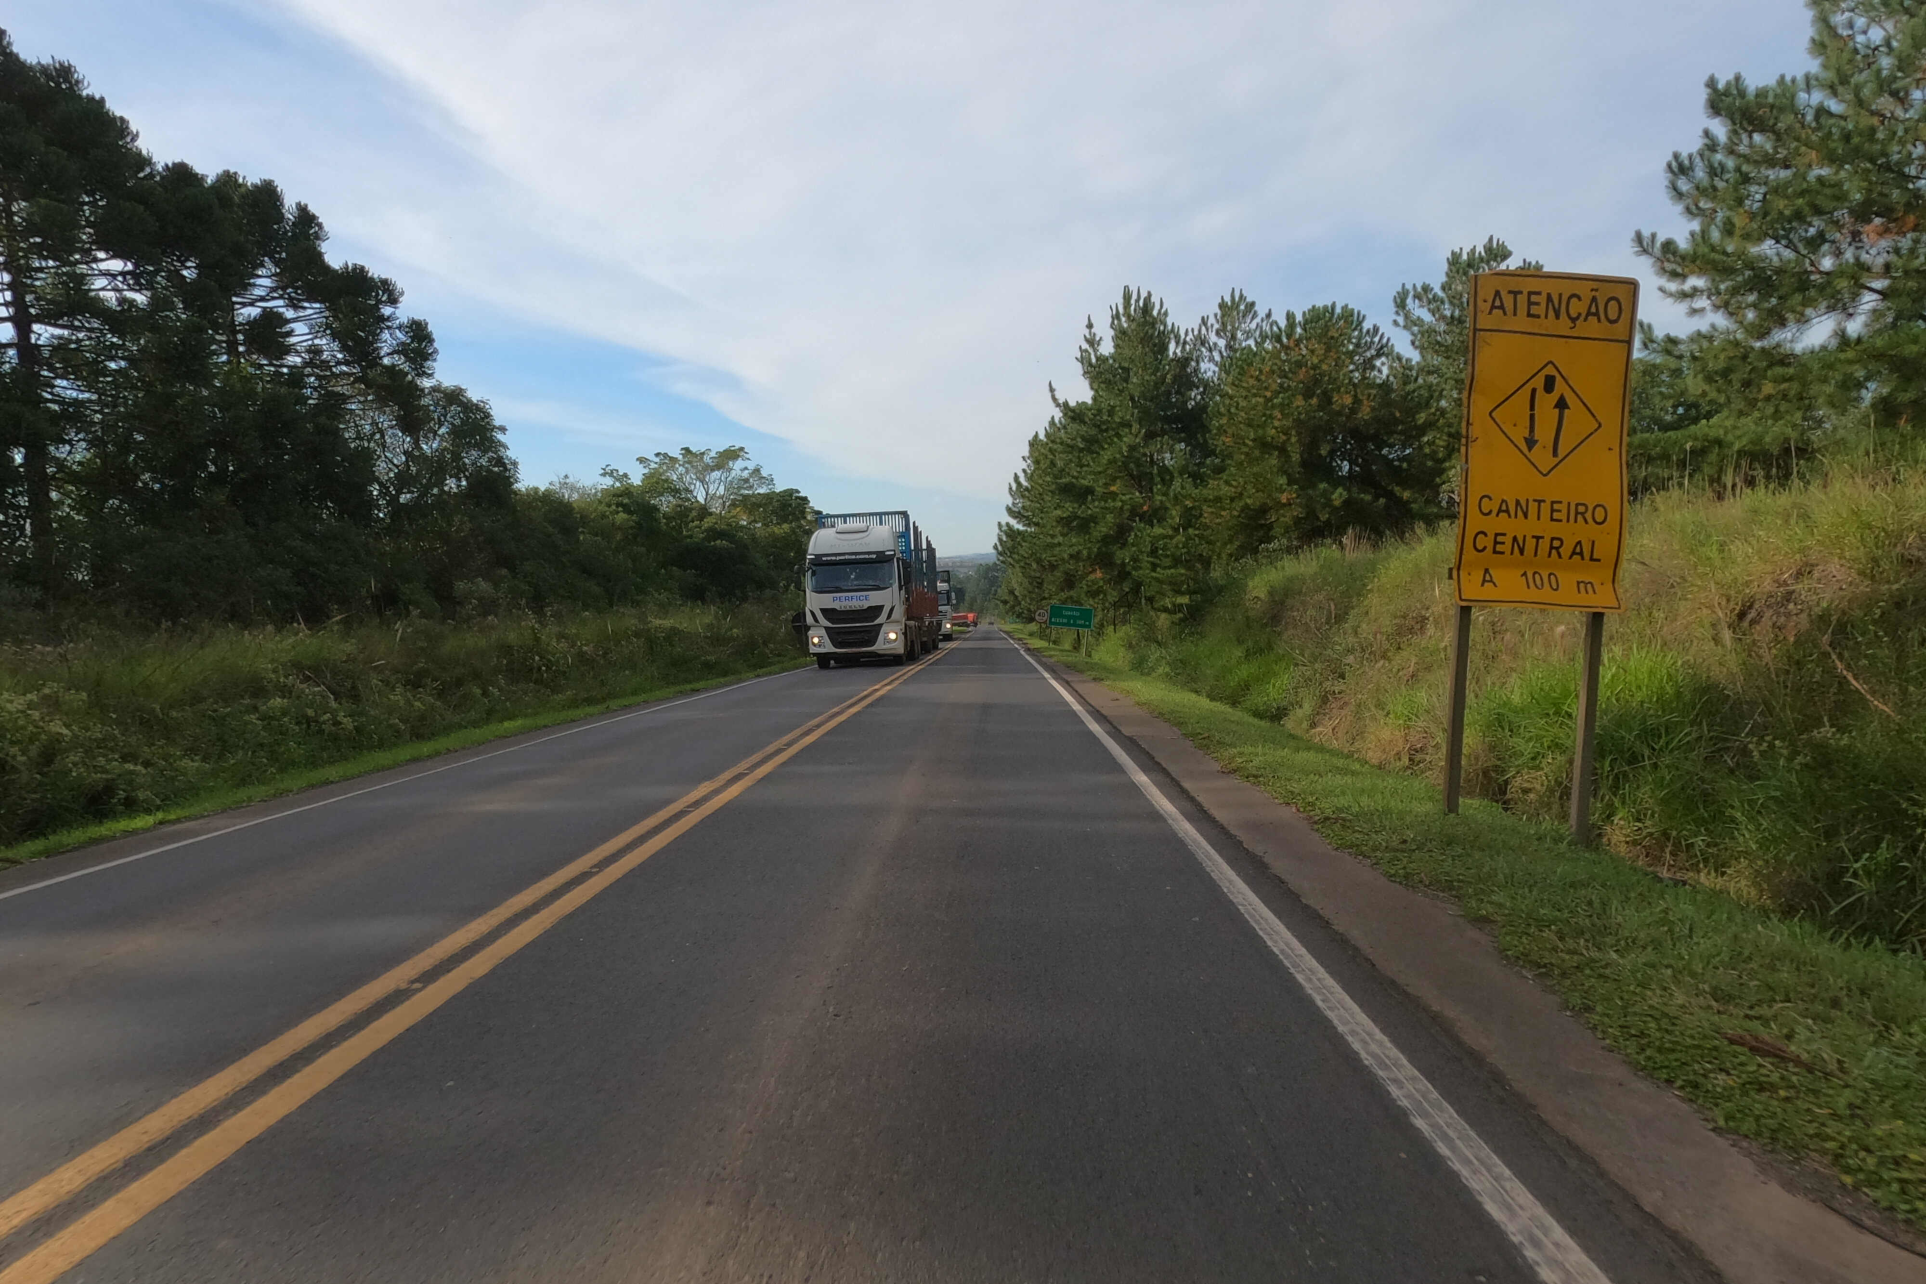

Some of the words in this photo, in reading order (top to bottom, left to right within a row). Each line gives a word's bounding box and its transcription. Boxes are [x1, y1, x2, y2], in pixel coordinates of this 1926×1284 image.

[1487, 287, 1623, 329] ATENÇÃO
[1478, 494, 1608, 525] CANTEIRO
[1473, 530, 1601, 562] CENTRAL
[1480, 568, 1498, 588] A
[1520, 570, 1560, 592] 100
[1576, 579, 1597, 595] m
[832, 594, 870, 603] PERFICE
